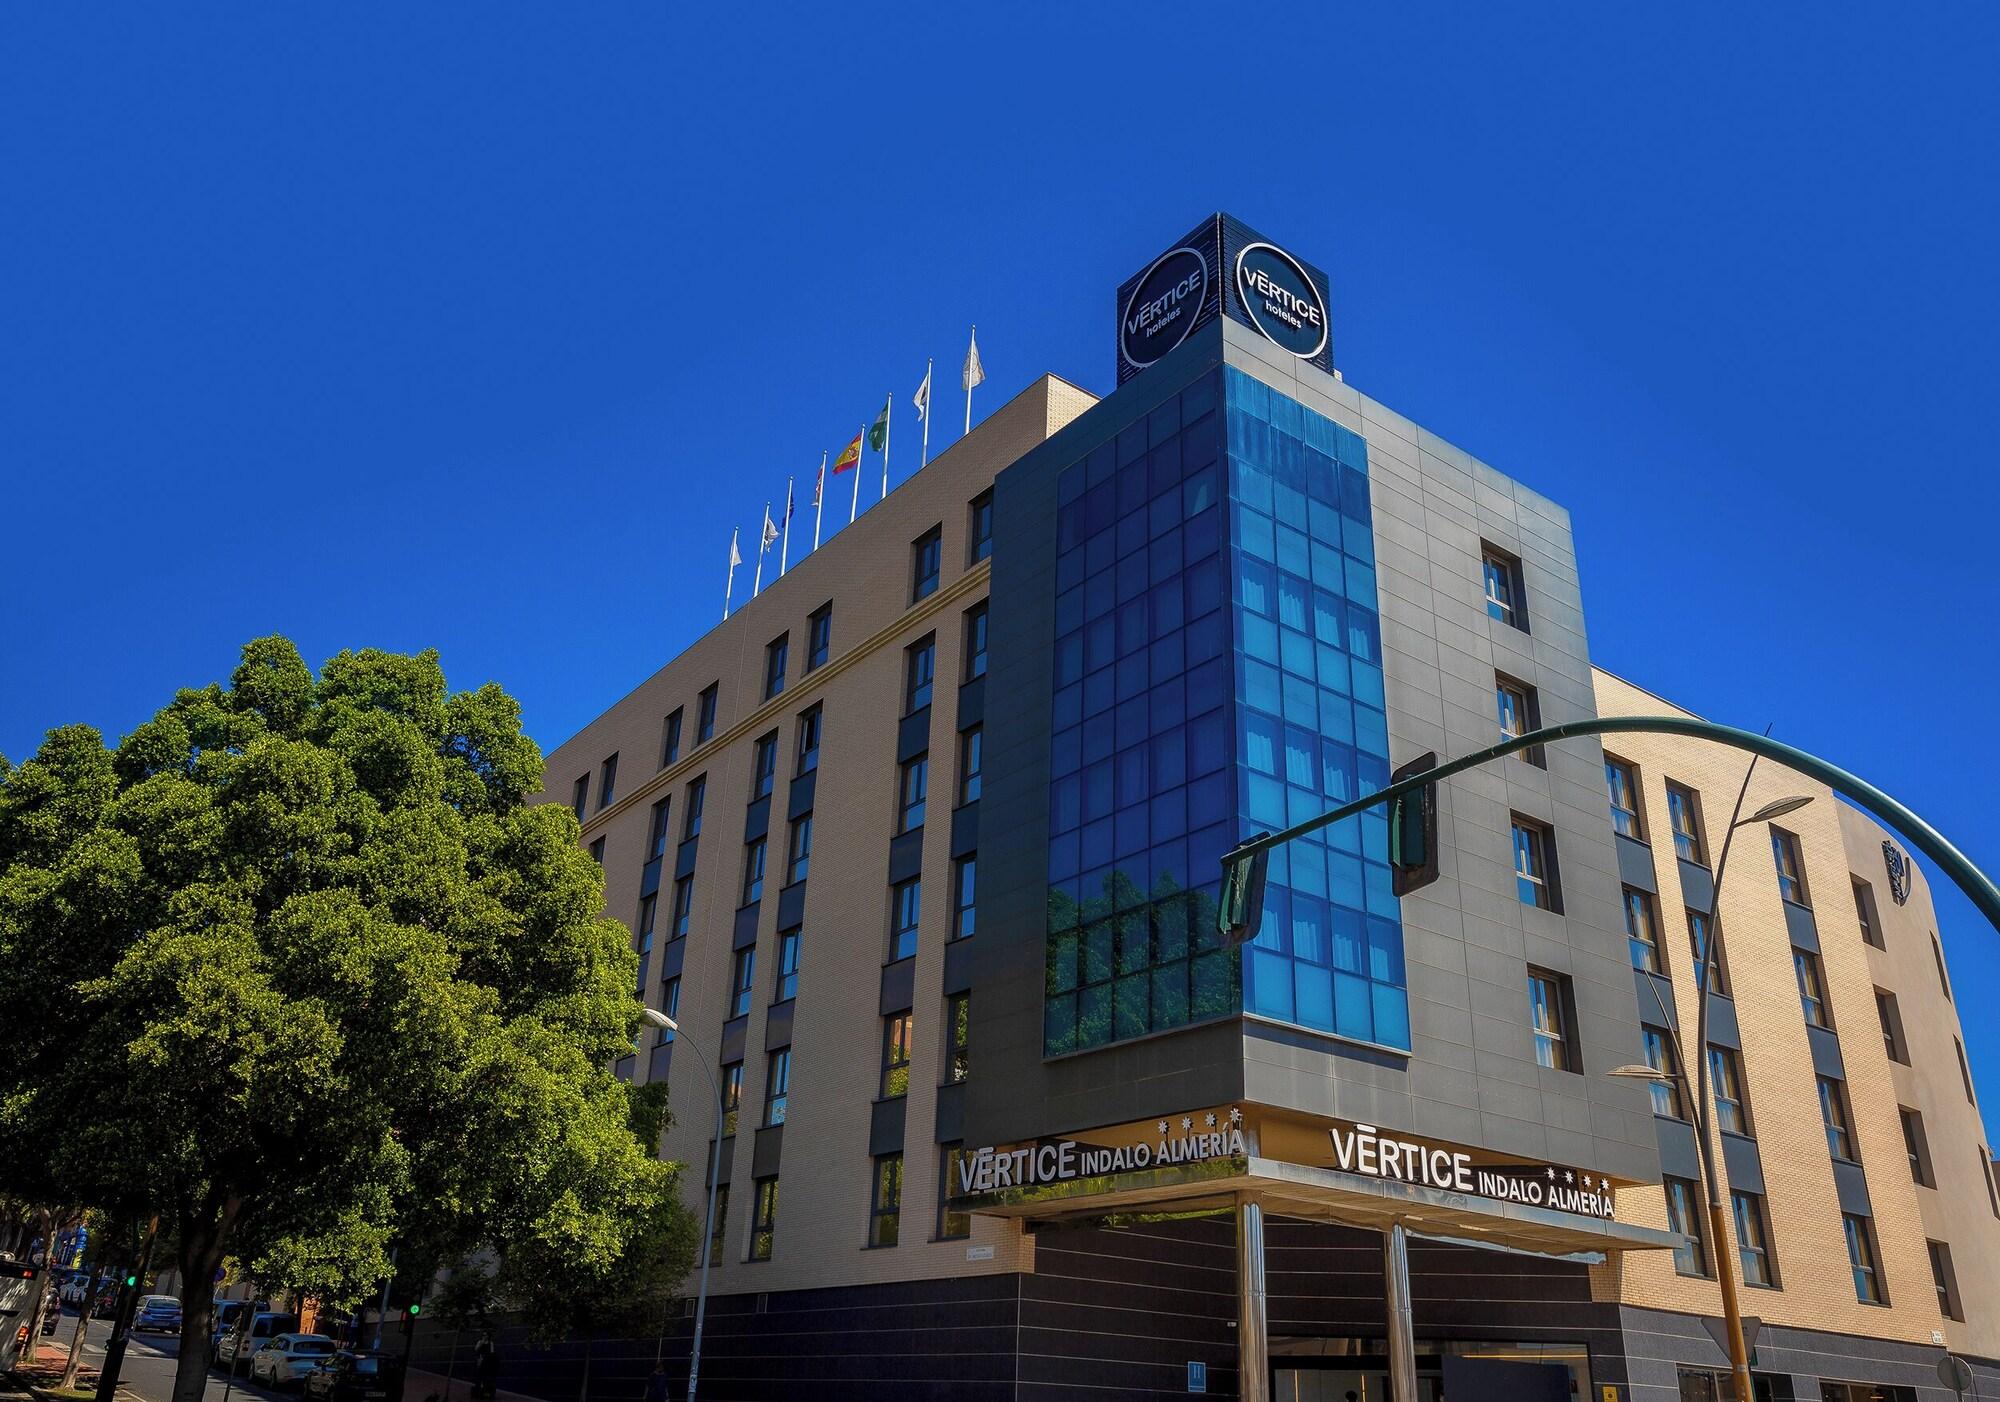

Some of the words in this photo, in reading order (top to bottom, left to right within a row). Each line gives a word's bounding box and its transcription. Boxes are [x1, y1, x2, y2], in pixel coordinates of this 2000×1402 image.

[1146, 309, 1181, 338] hoteles
[1266, 301, 1302, 328] hoteles
[1081, 1143, 1150, 1176] INDALO
[1156, 1122, 1245, 1165] ALMERÍA
[1479, 1172, 1541, 1204] INDALO
[1548, 1186, 1616, 1218] ALMERÍA
